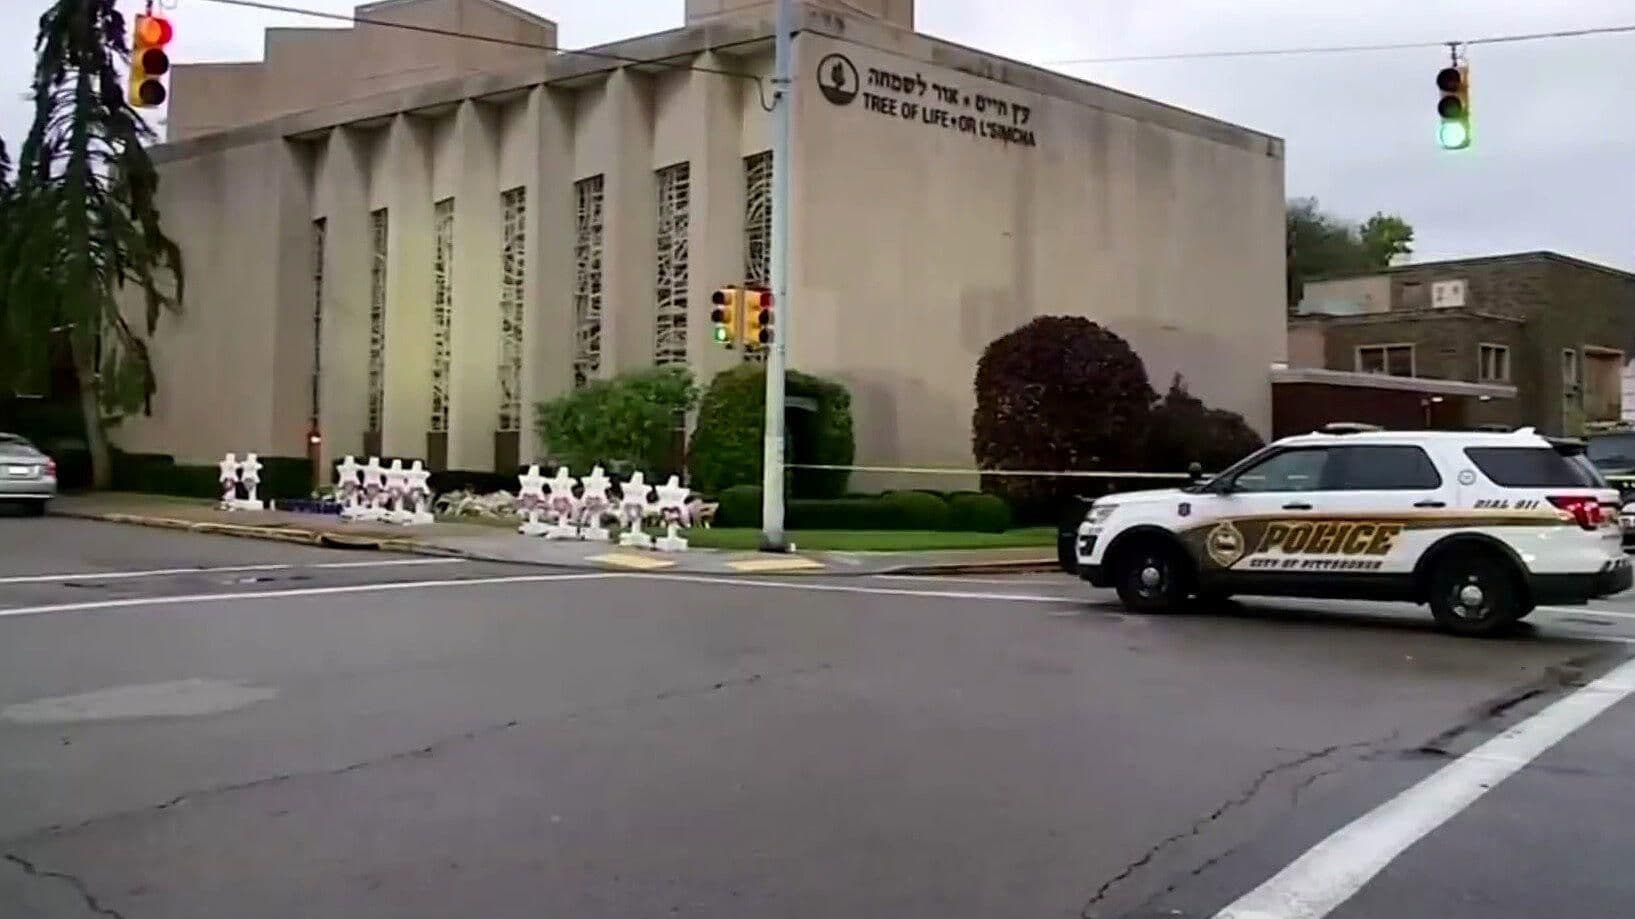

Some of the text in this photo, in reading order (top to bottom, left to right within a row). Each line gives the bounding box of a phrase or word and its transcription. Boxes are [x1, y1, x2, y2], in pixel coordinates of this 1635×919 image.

[868, 67, 927, 96] לשמחה
[932, 83, 958, 104] אור
[862, 91, 898, 116] TREE
[901, 101, 918, 119] OF
[922, 106, 949, 128] LIFE
[959, 114, 977, 134] OR
[1474, 499, 1540, 509] DIAL 911
[1256, 522, 1402, 555] POLICE
[1249, 559, 1279, 568] CITY
[1281, 559, 1299, 568] OF
